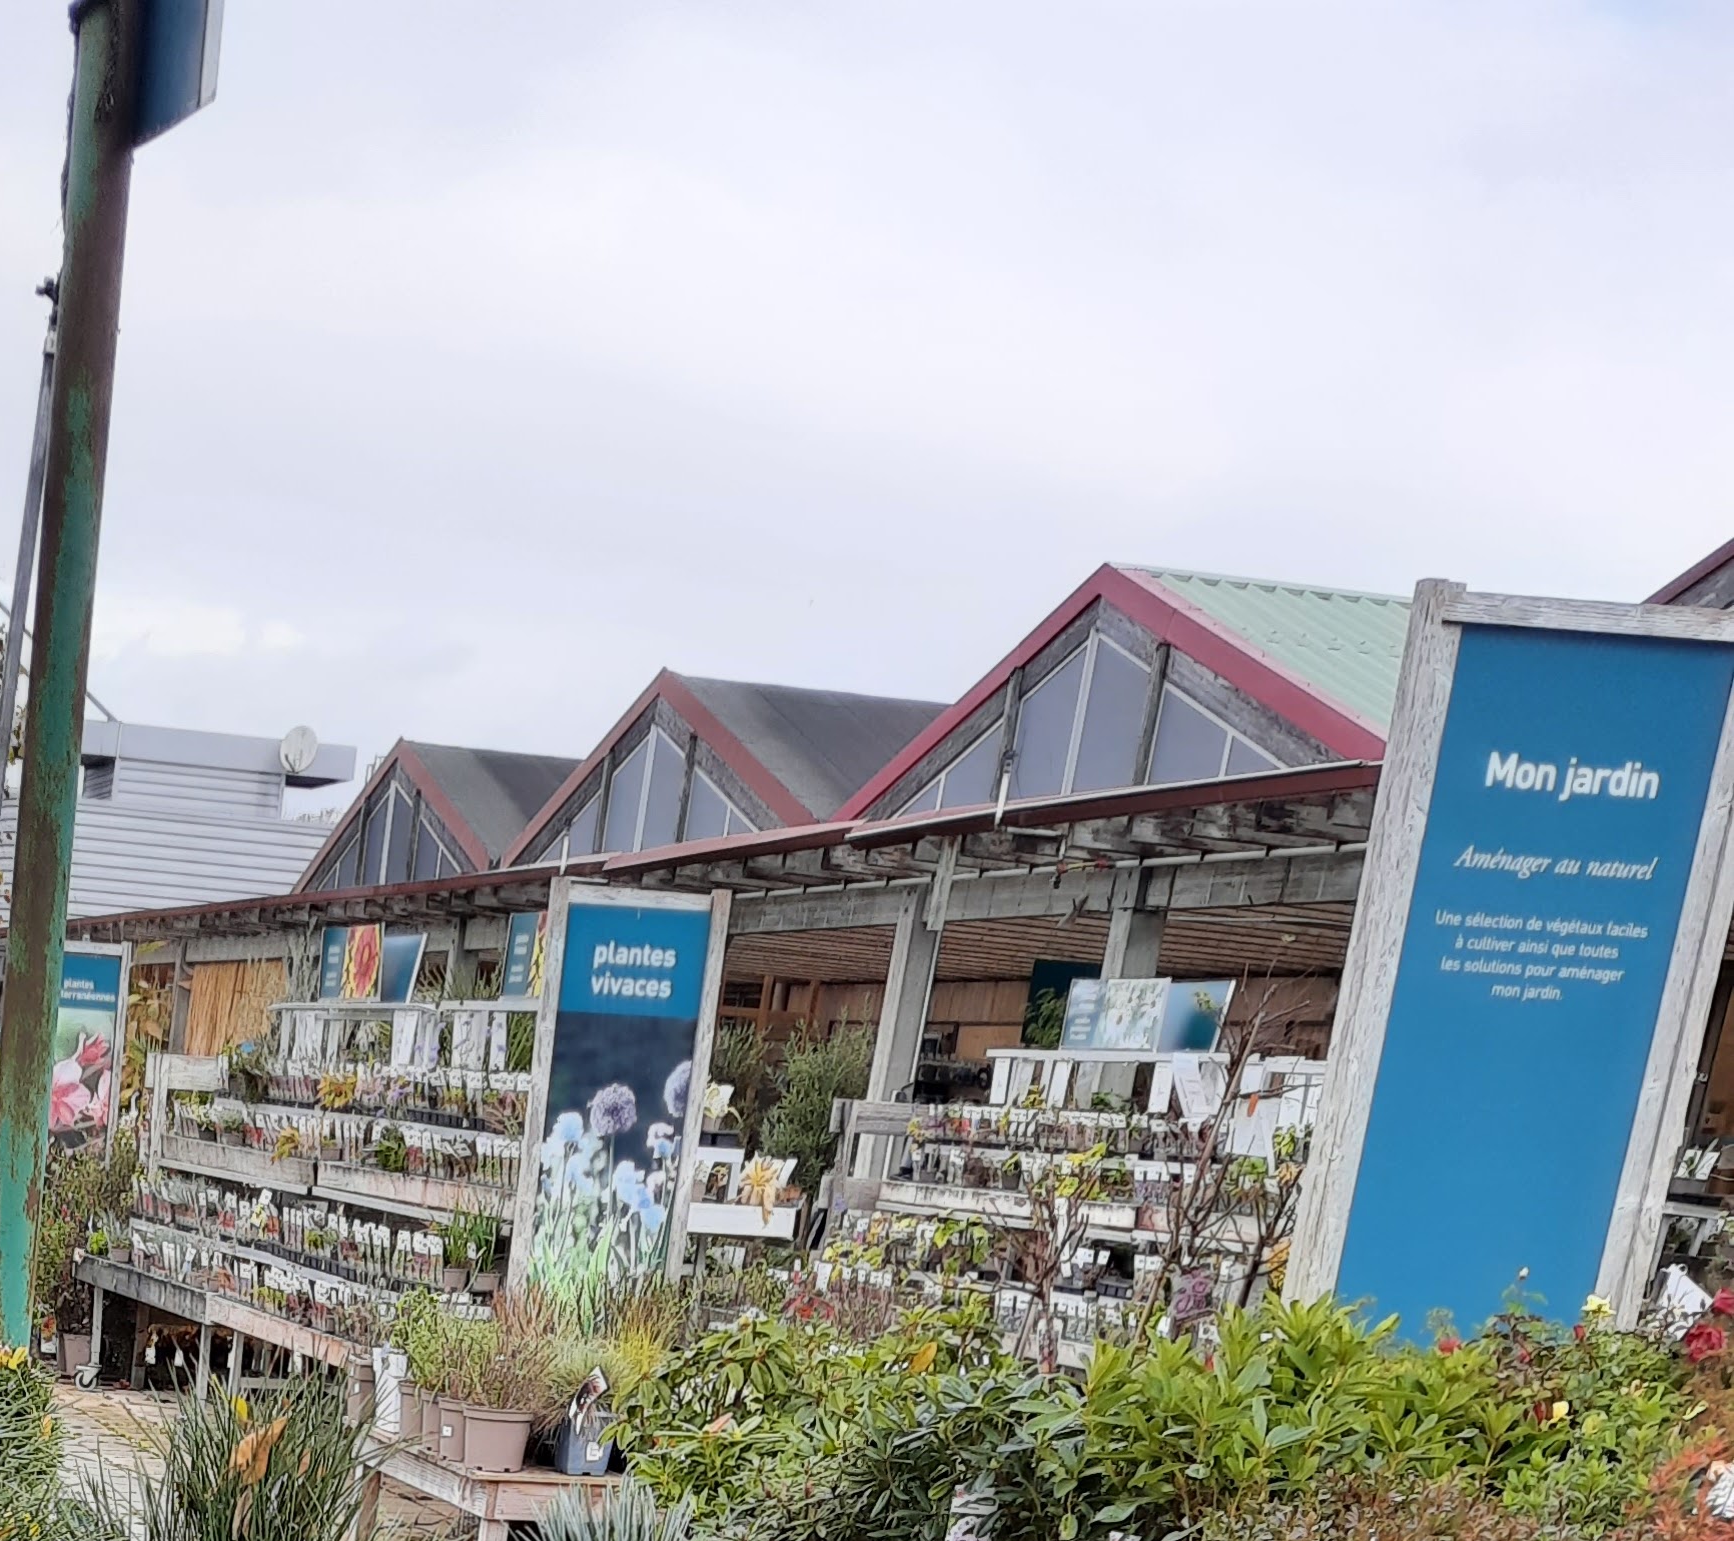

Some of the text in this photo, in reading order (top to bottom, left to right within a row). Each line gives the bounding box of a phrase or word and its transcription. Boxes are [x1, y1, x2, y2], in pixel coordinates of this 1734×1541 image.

[1485, 751, 1660, 801] Mon jardin
[1454, 845, 1659, 880] Aménager au naturel
[1435, 909, 1649, 939] Une sélection de végétaux faciles
[593, 940, 677, 970] plantes
[1455, 934, 1619, 959] à cultiver ainsi que toutes
[591, 971, 672, 998] vivaces
[1440, 955, 1625, 985] les solutions pour aménager
[1490, 984, 1520, 998] mon
